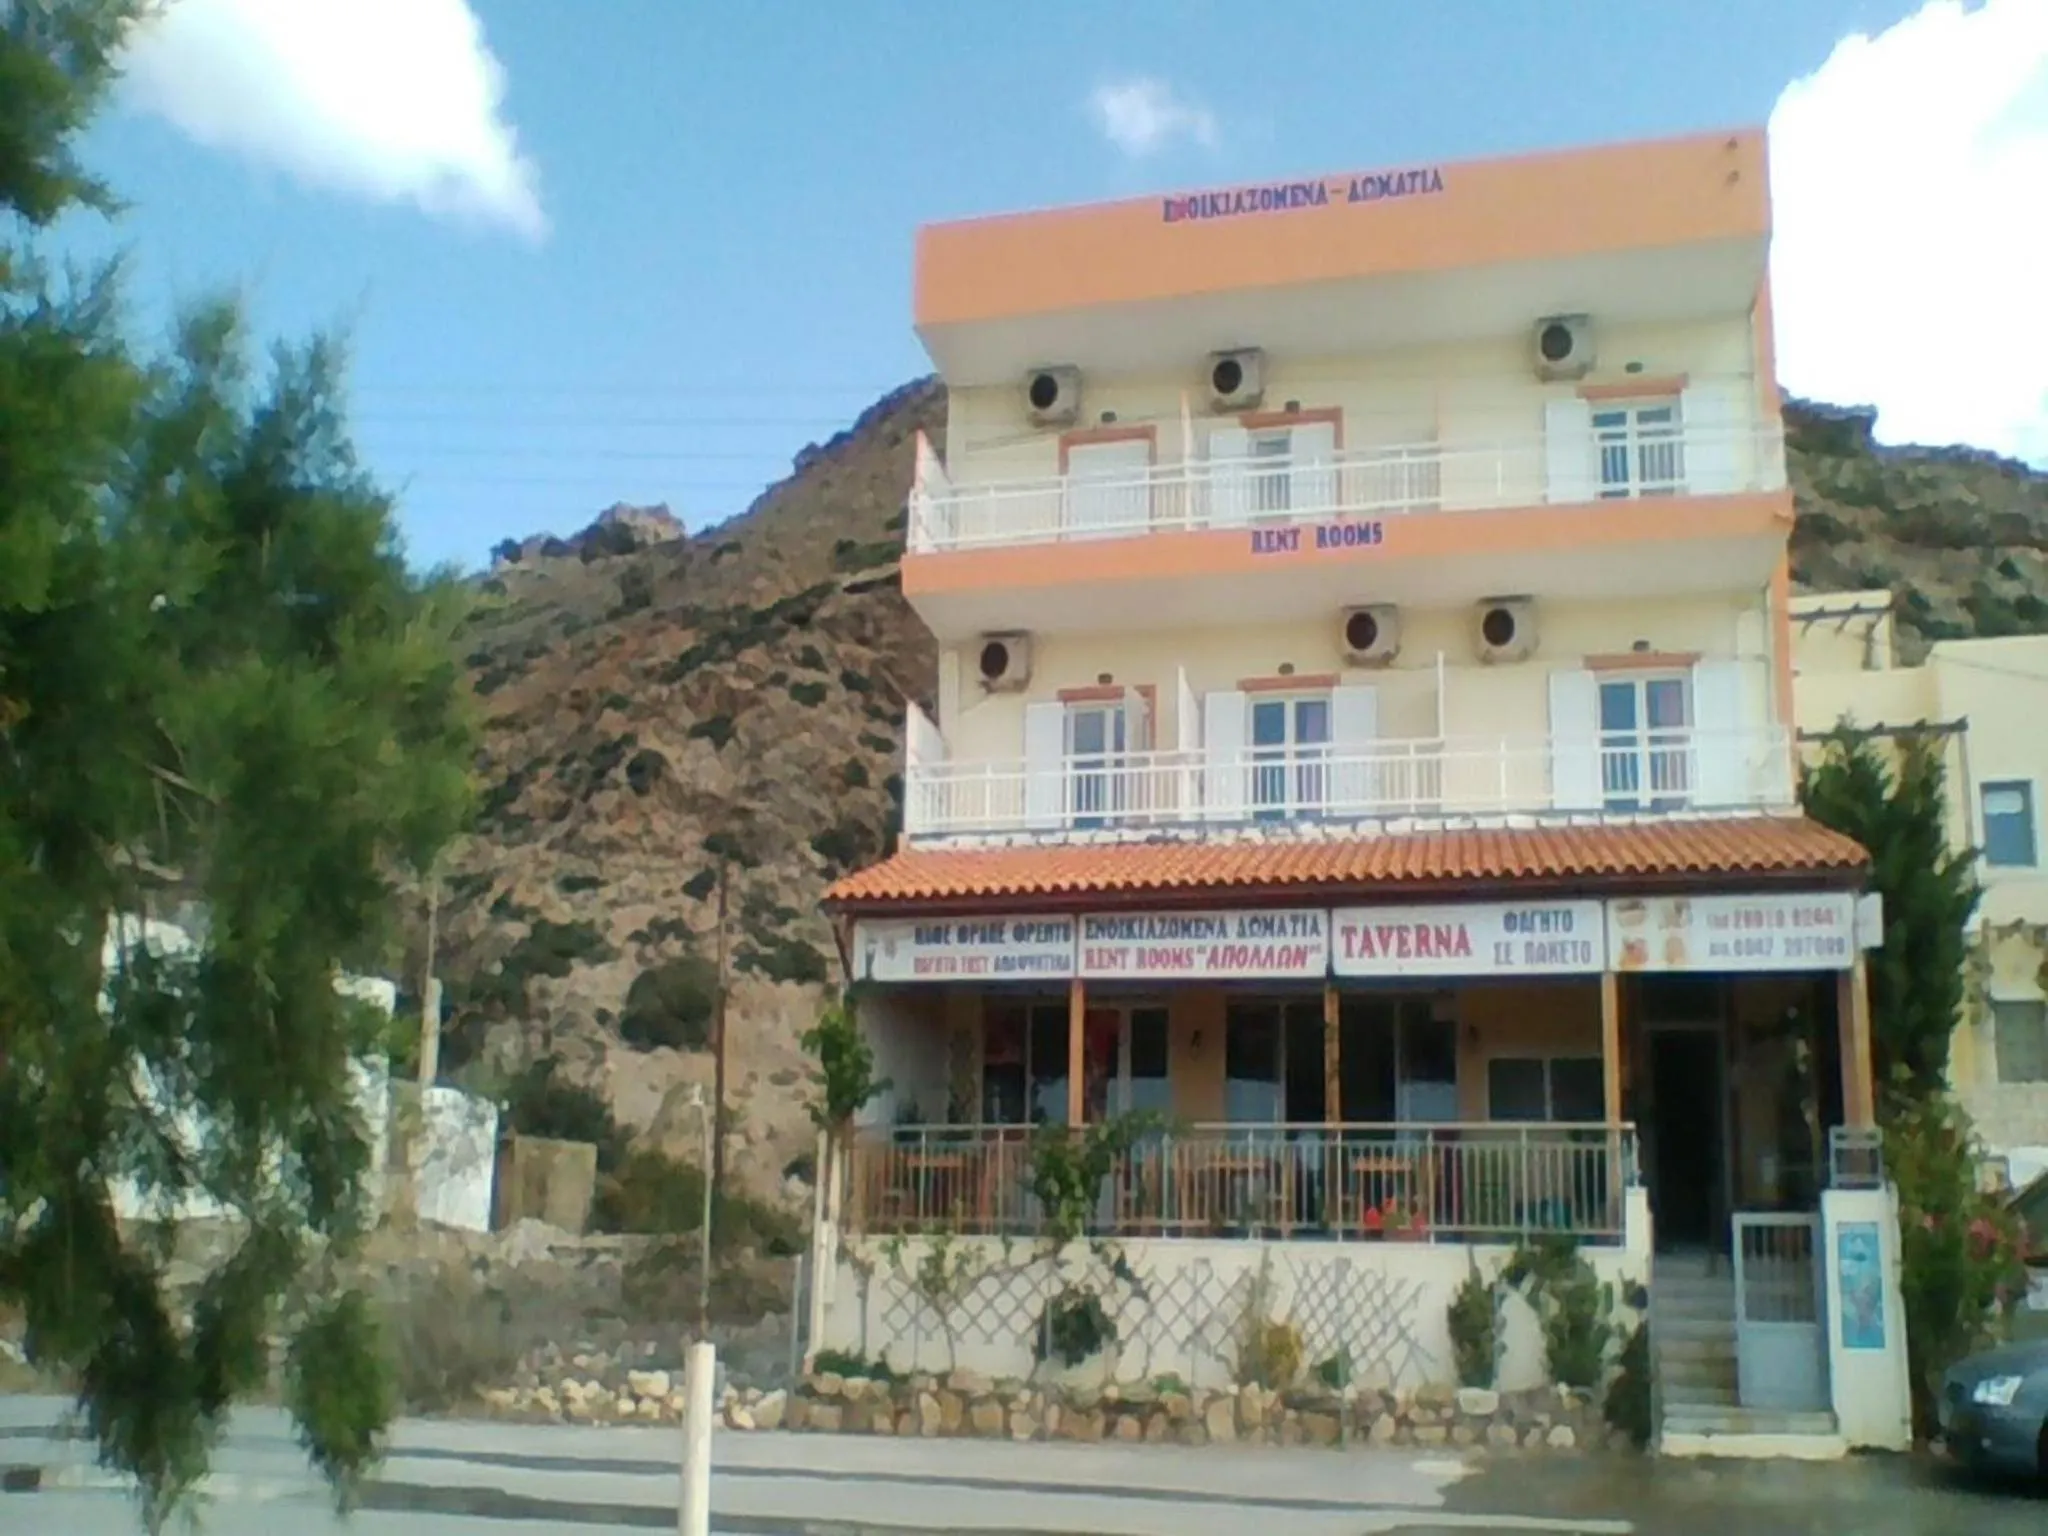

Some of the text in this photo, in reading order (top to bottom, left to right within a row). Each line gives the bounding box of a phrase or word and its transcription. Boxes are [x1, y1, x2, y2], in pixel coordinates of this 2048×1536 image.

[1163, 179, 1328, 222] ΕΟΙΚΙΑΖΟΜΕΝΑ
[1252, 521, 1383, 554] RENT ROOMS
[1085, 912, 1322, 941] ΕΝΟΙΚΙΑΖΟΜΕΝΑ ΔΩΜΑΤΙΑ
[1503, 909, 1574, 933] ΦΑΓΗΤΟ
[1340, 923, 1473, 959] TAVERNA
[1085, 946, 1130, 970] RENT
[1136, 946, 1194, 970] ROOMS
